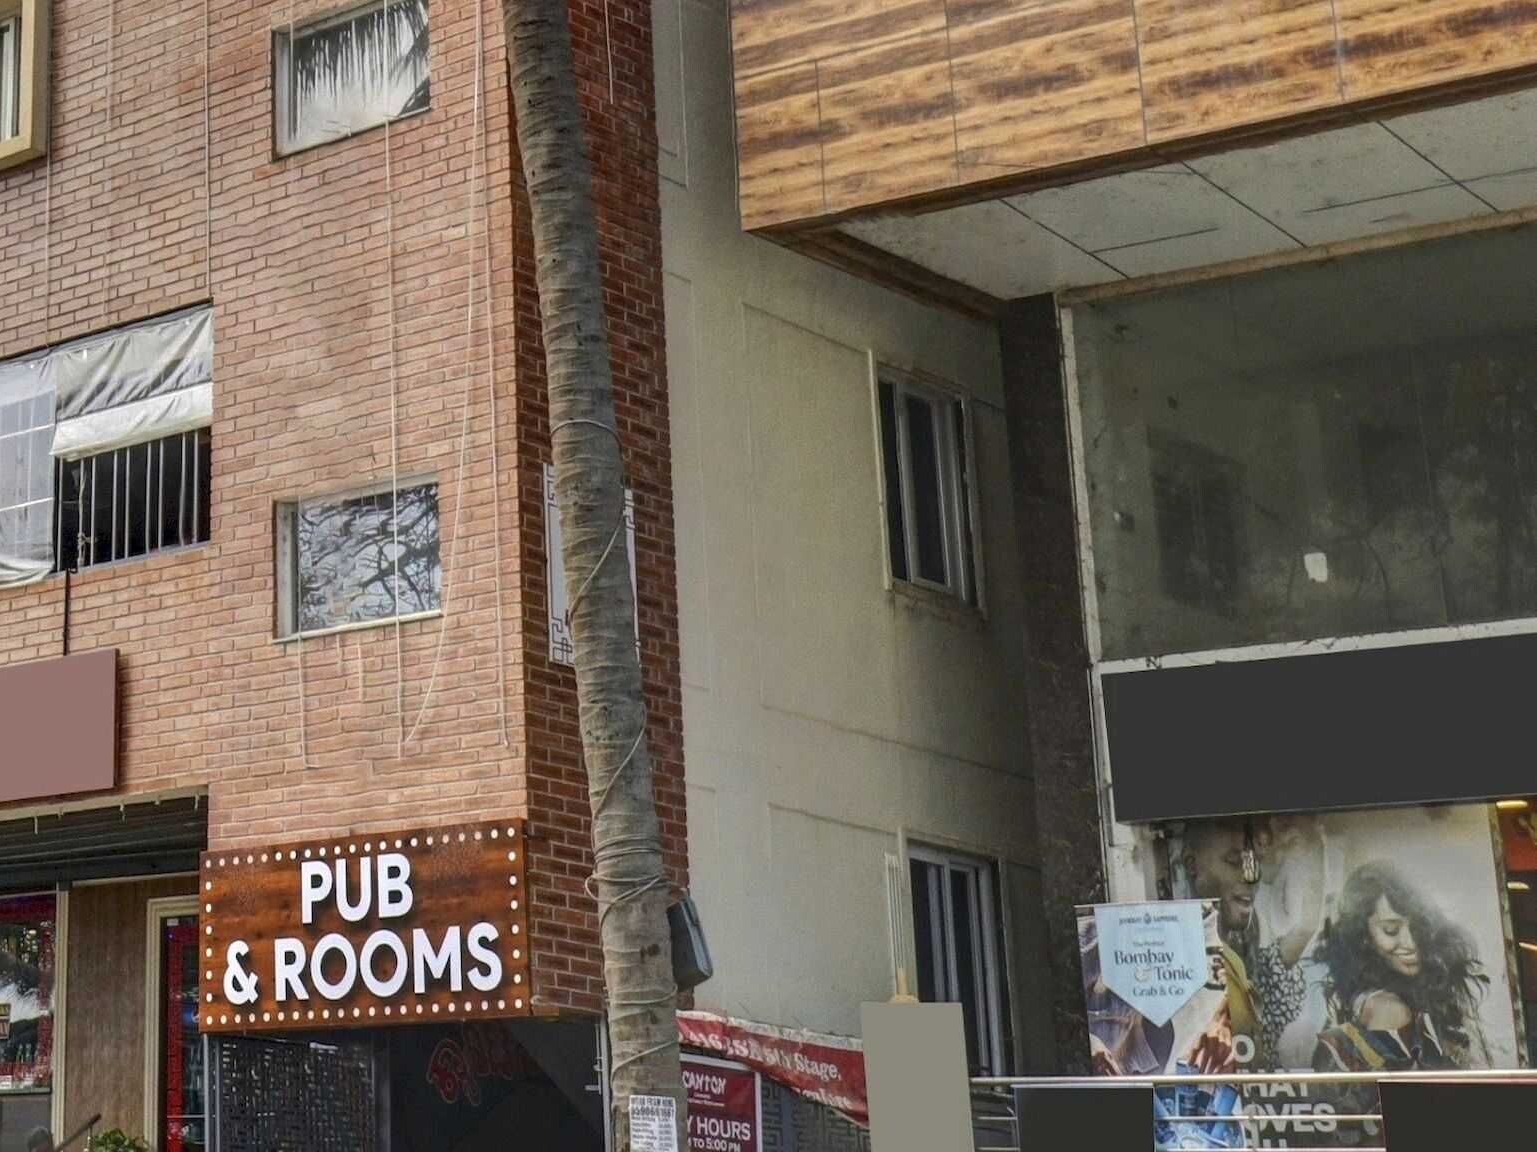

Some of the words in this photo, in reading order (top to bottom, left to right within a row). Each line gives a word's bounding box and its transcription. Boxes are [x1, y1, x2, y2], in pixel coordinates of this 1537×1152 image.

[301, 853, 413, 924] PUB
[223, 940, 259, 1005] &
[274, 922, 503, 1001] ROOMS
[1114, 949, 1175, 965] Bombay
[1154, 966, 1194, 981] Tonic
[1132, 986, 1158, 997] Grab
[1168, 985, 1184, 995] Go
[682, 1069, 726, 1095] CANTON
[697, 1116, 751, 1141] HOURS
[693, 1137, 705, 1148] TO
